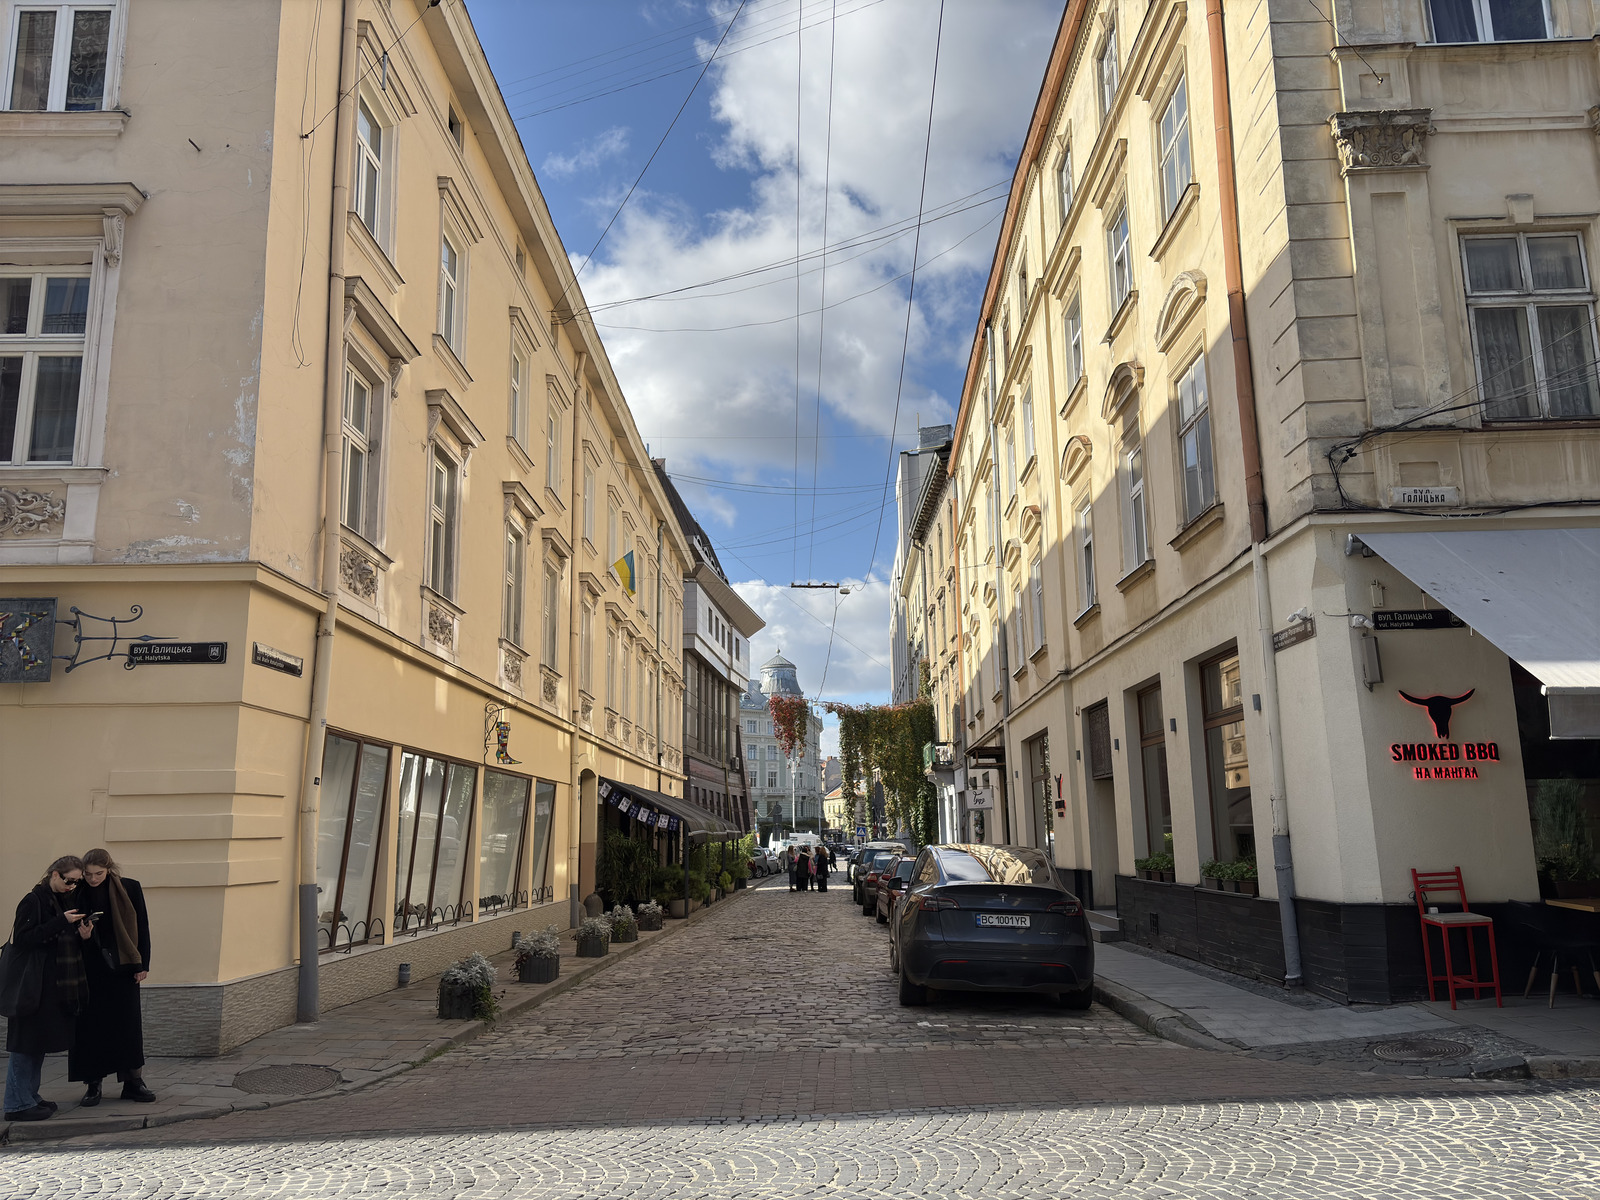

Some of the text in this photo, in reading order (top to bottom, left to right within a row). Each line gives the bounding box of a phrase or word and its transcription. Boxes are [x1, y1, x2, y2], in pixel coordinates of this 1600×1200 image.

[1394, 612, 1433, 622] Галицька
[133, 645, 192, 655] вул. Галицька
[1391, 742, 1500, 761] SMOKED BBQ
[1415, 766, 1479, 779] НА МАНГАЛ
[981, 915, 1027, 926] BC 1001 YR
